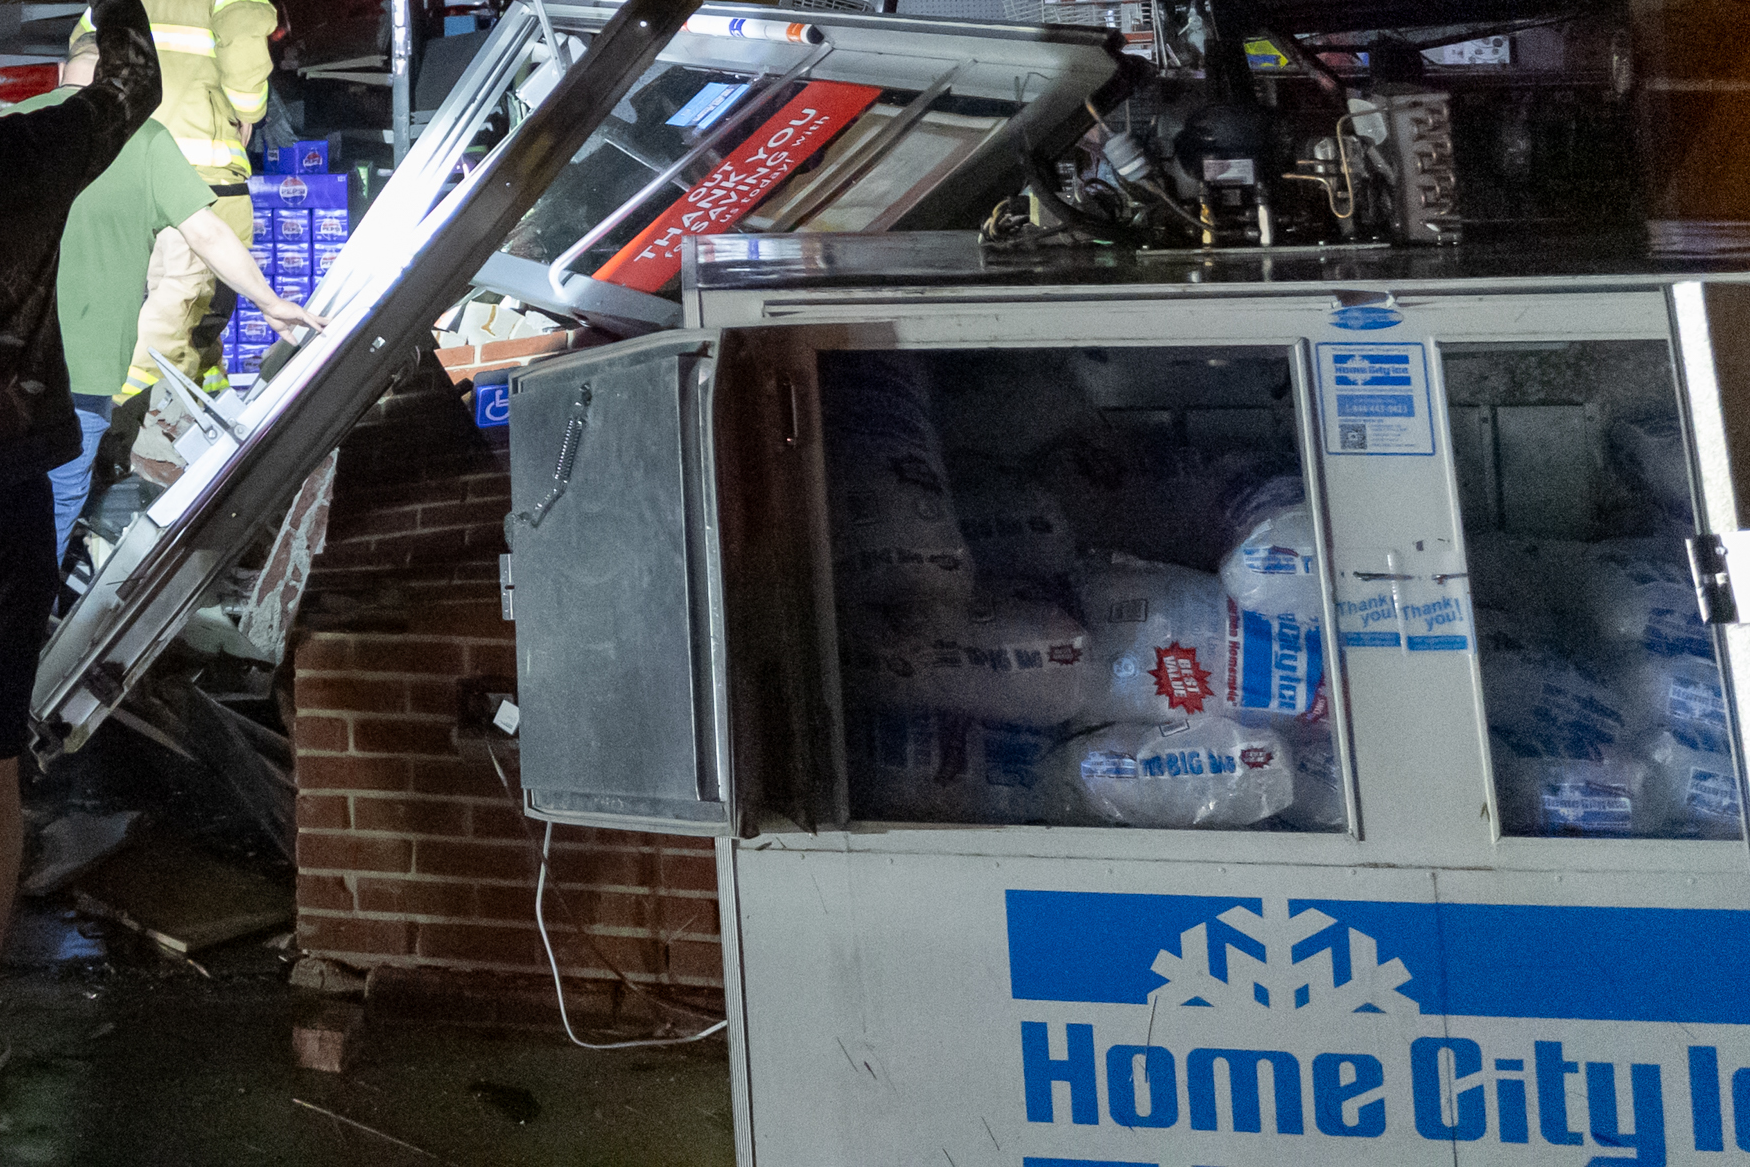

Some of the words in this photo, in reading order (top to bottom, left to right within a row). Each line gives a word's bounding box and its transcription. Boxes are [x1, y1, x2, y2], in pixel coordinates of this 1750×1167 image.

[634, 172, 747, 262] THANK
[745, 107, 818, 164] YOU
[688, 161, 735, 202] OUT
[691, 150, 789, 233] SAVING
[791, 115, 831, 148] with
[719, 207, 740, 224] us
[740, 159, 796, 204] today!
[1335, 366, 1367, 375] Home
[1368, 366, 1391, 377] City
[1337, 594, 1388, 616] Thank
[1401, 596, 1453, 621] Thank
[1424, 598, 1464, 632] you!
[1163, 655, 1188, 698] VALUE
[1177, 658, 1200, 695] BEST
[1166, 750, 1203, 777] BIG
[1020, 1020, 1386, 1139] Home
[1410, 1037, 1666, 1167] City
